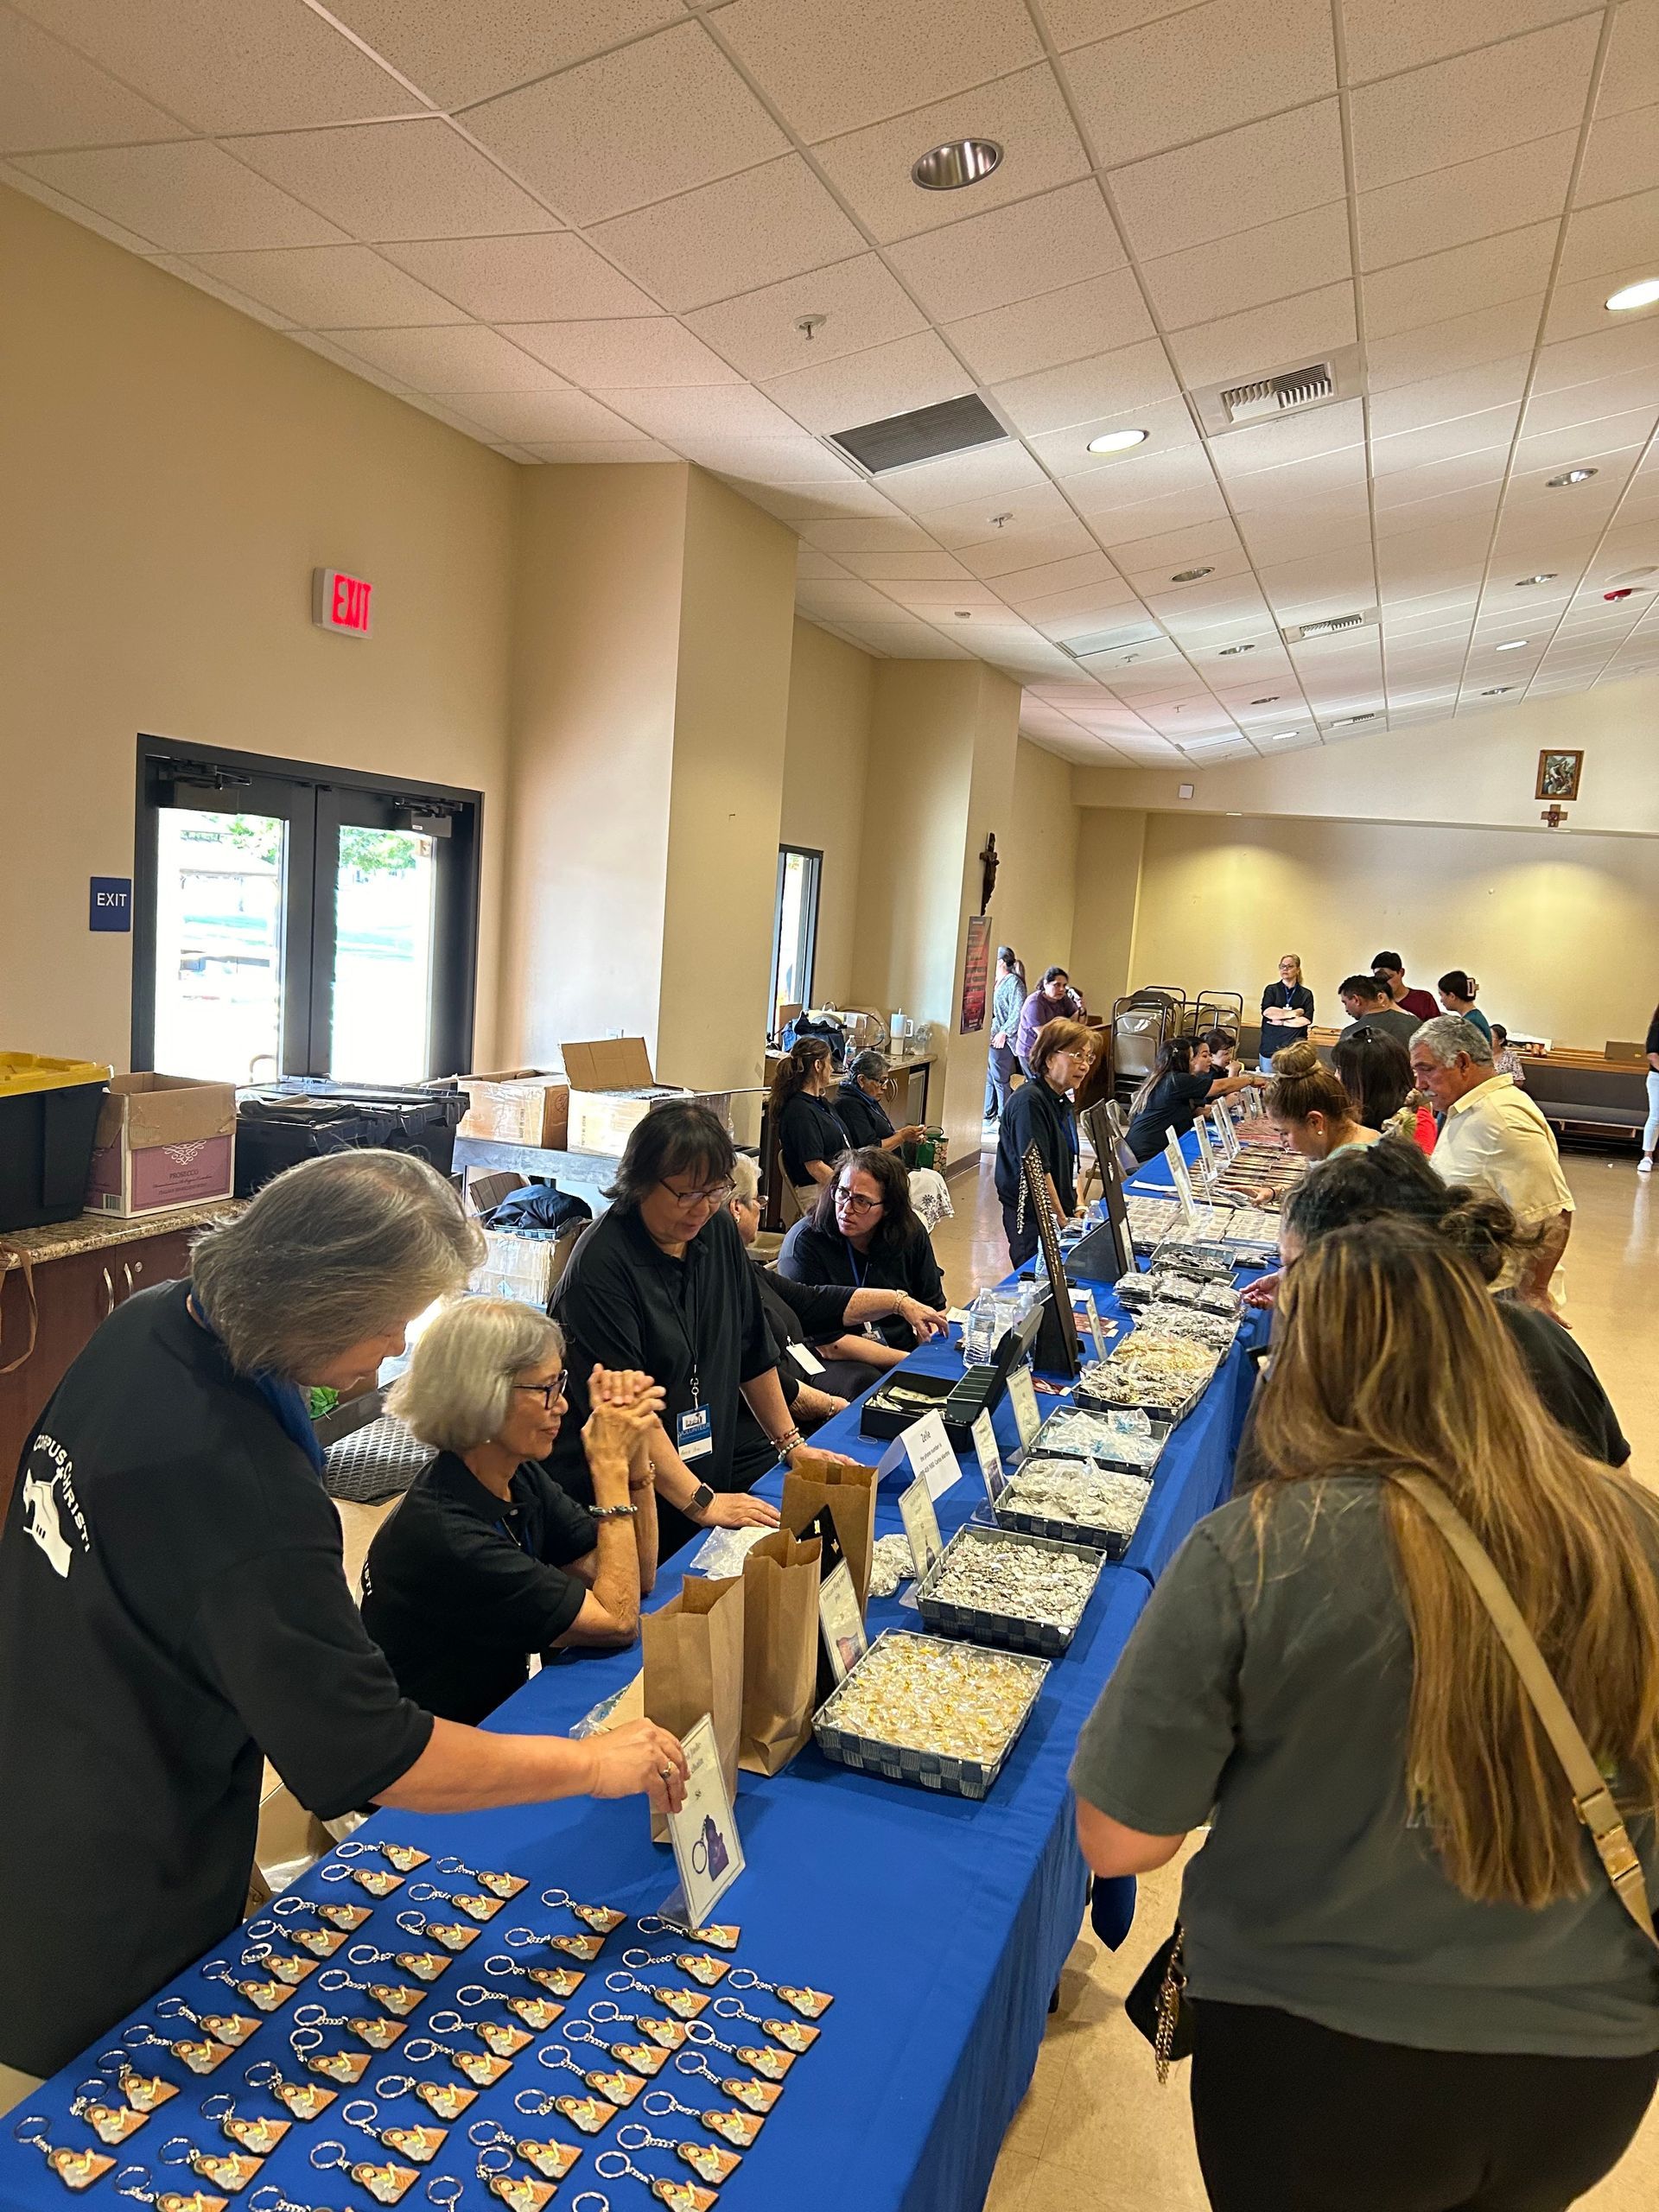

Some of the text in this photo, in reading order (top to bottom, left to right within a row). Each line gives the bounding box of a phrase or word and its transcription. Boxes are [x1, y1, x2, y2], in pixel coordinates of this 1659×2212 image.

[332, 573, 372, 632] EXIT
[97, 892, 127, 907] EXIT
[169, 1169, 199, 1179] PROSECCO
